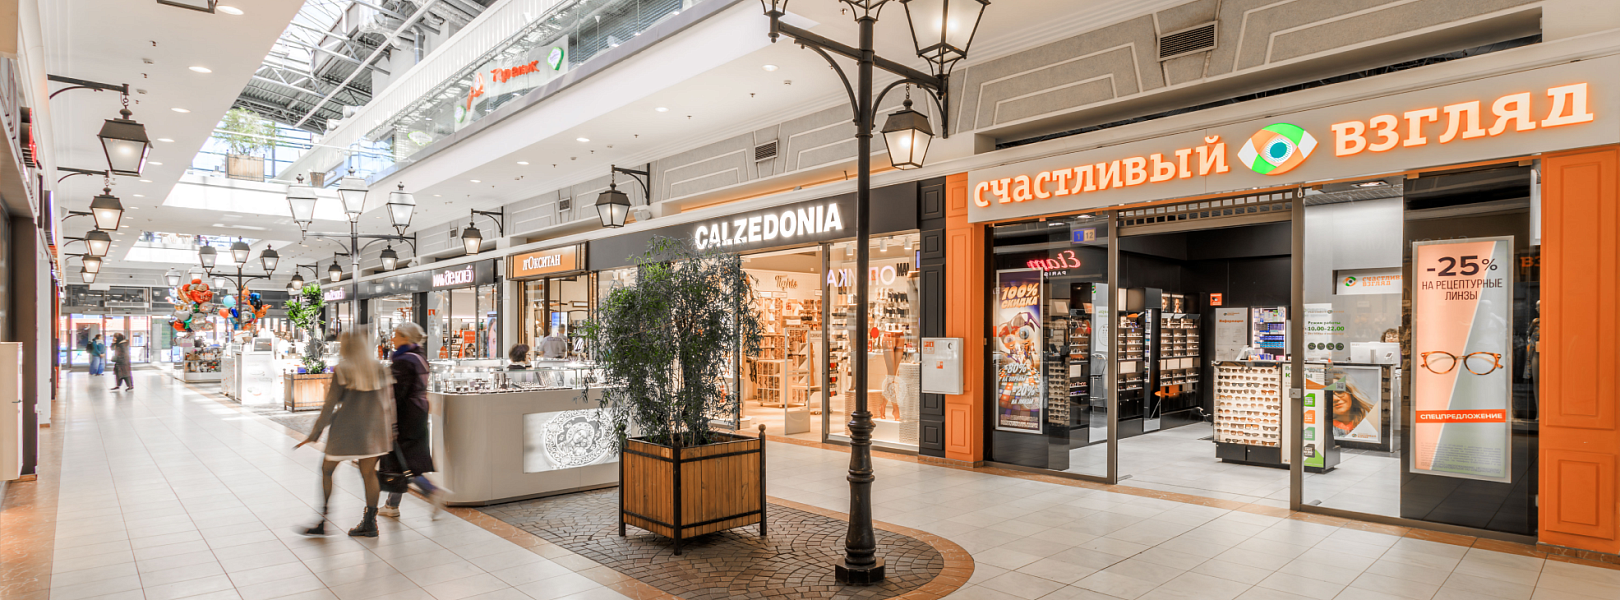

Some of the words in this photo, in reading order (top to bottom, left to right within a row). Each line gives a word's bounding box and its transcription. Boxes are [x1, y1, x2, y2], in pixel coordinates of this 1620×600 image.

[694, 202, 843, 250] CALZEDONIA
[1427, 255, 1498, 277] -25%
[1002, 283, 1039, 300] 100%
[1422, 281, 1434, 290] НА
[1436, 278, 1503, 290] РЕЦЕПТУРНЫЕ
[1445, 291, 1478, 301] ЛИНЗЫ
